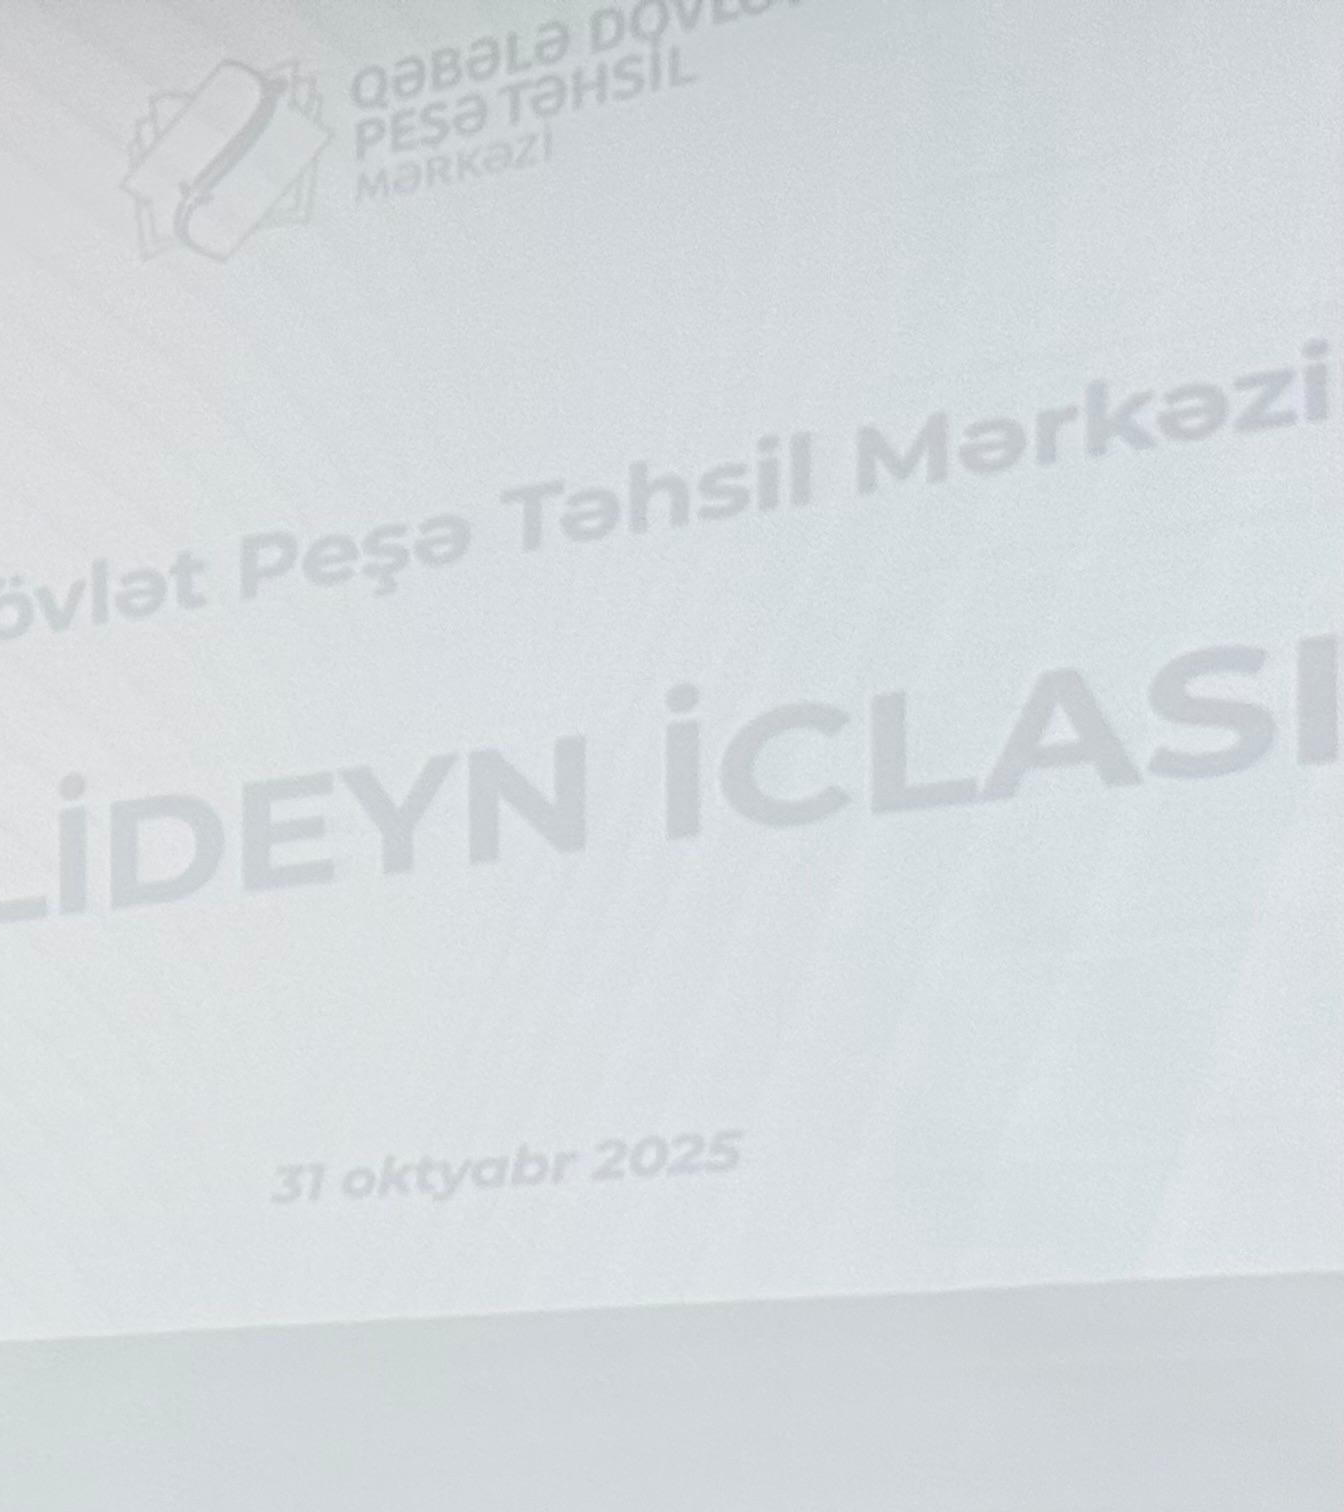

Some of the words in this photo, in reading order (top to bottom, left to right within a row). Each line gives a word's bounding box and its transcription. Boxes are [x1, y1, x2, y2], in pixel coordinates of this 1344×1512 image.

[350, 19, 571, 109] QƏBƏLƏ
[236, 509, 474, 602] Peşə
[502, 430, 812, 554] Təhsil
[854, 338, 1330, 497] Mərkəzi
[665, 633, 1339, 844] İCLASI
[272, 1162, 325, 1202] 31
[342, 1142, 576, 1201] oktyabr
[592, 1130, 744, 1181] 2025
